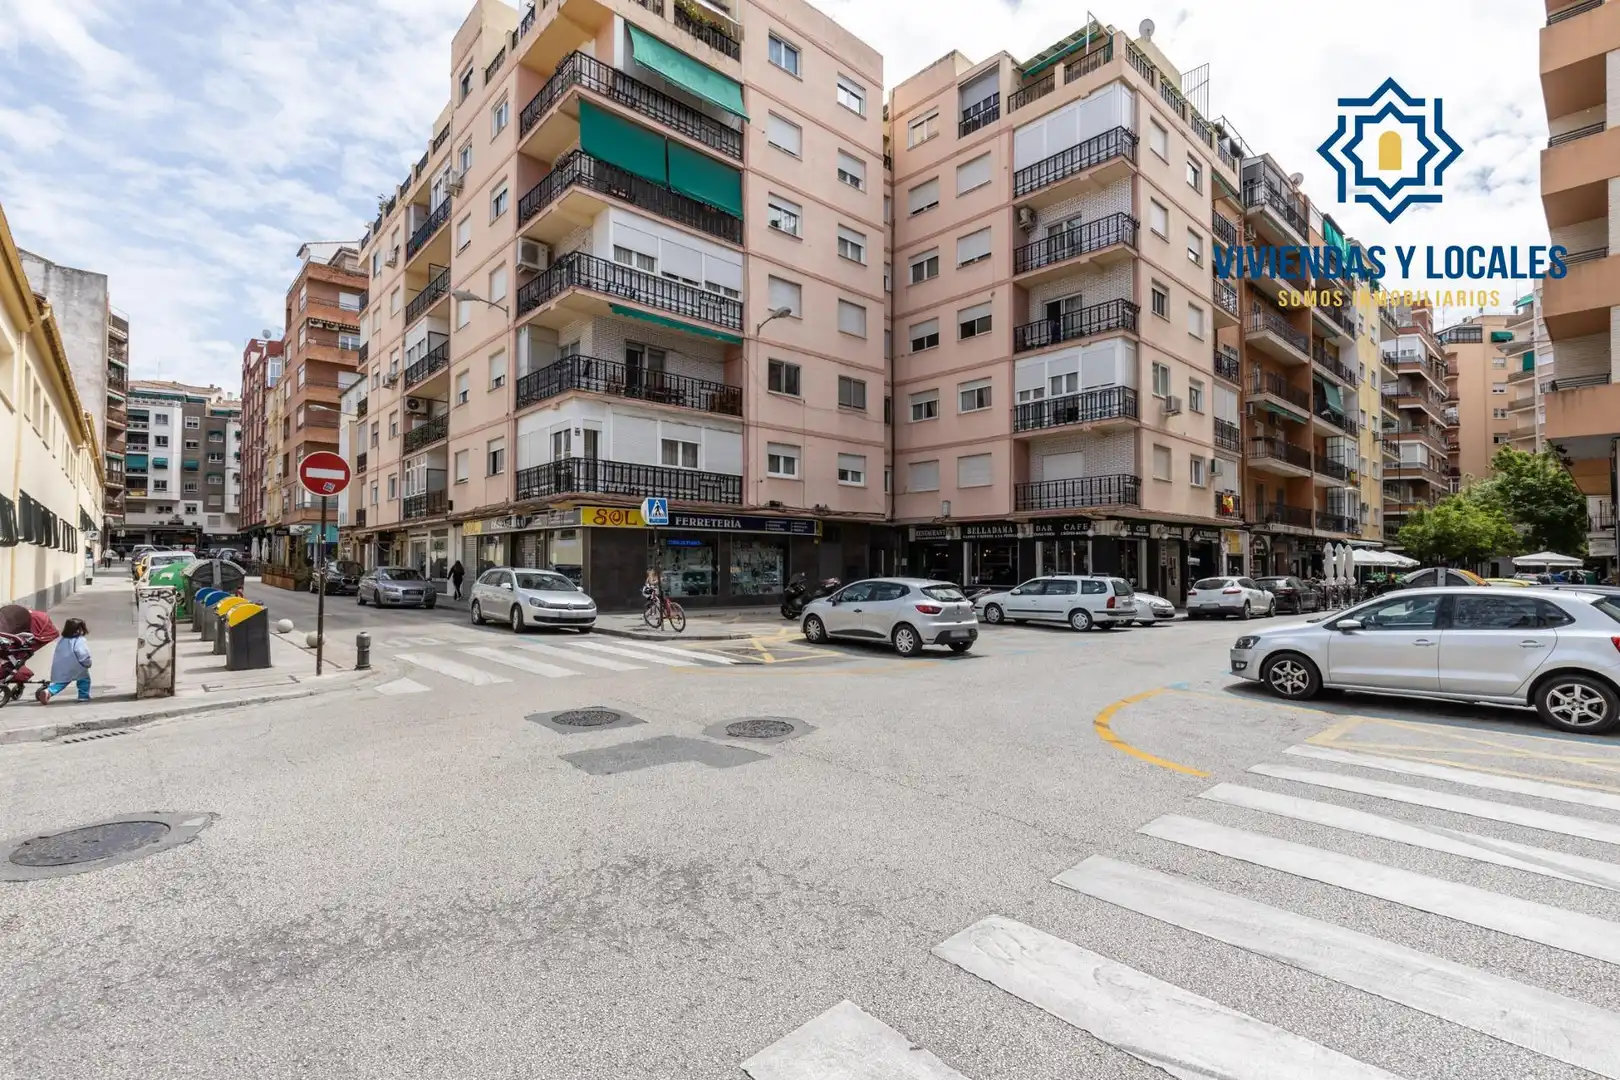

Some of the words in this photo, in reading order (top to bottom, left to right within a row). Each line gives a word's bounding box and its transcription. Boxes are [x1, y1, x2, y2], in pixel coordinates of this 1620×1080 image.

[592, 508, 637, 526] SOL
[675, 515, 742, 529] FERRETERÍA
[966, 525, 1013, 535] BELLADAMA
[1035, 524, 1053, 532] BAR
